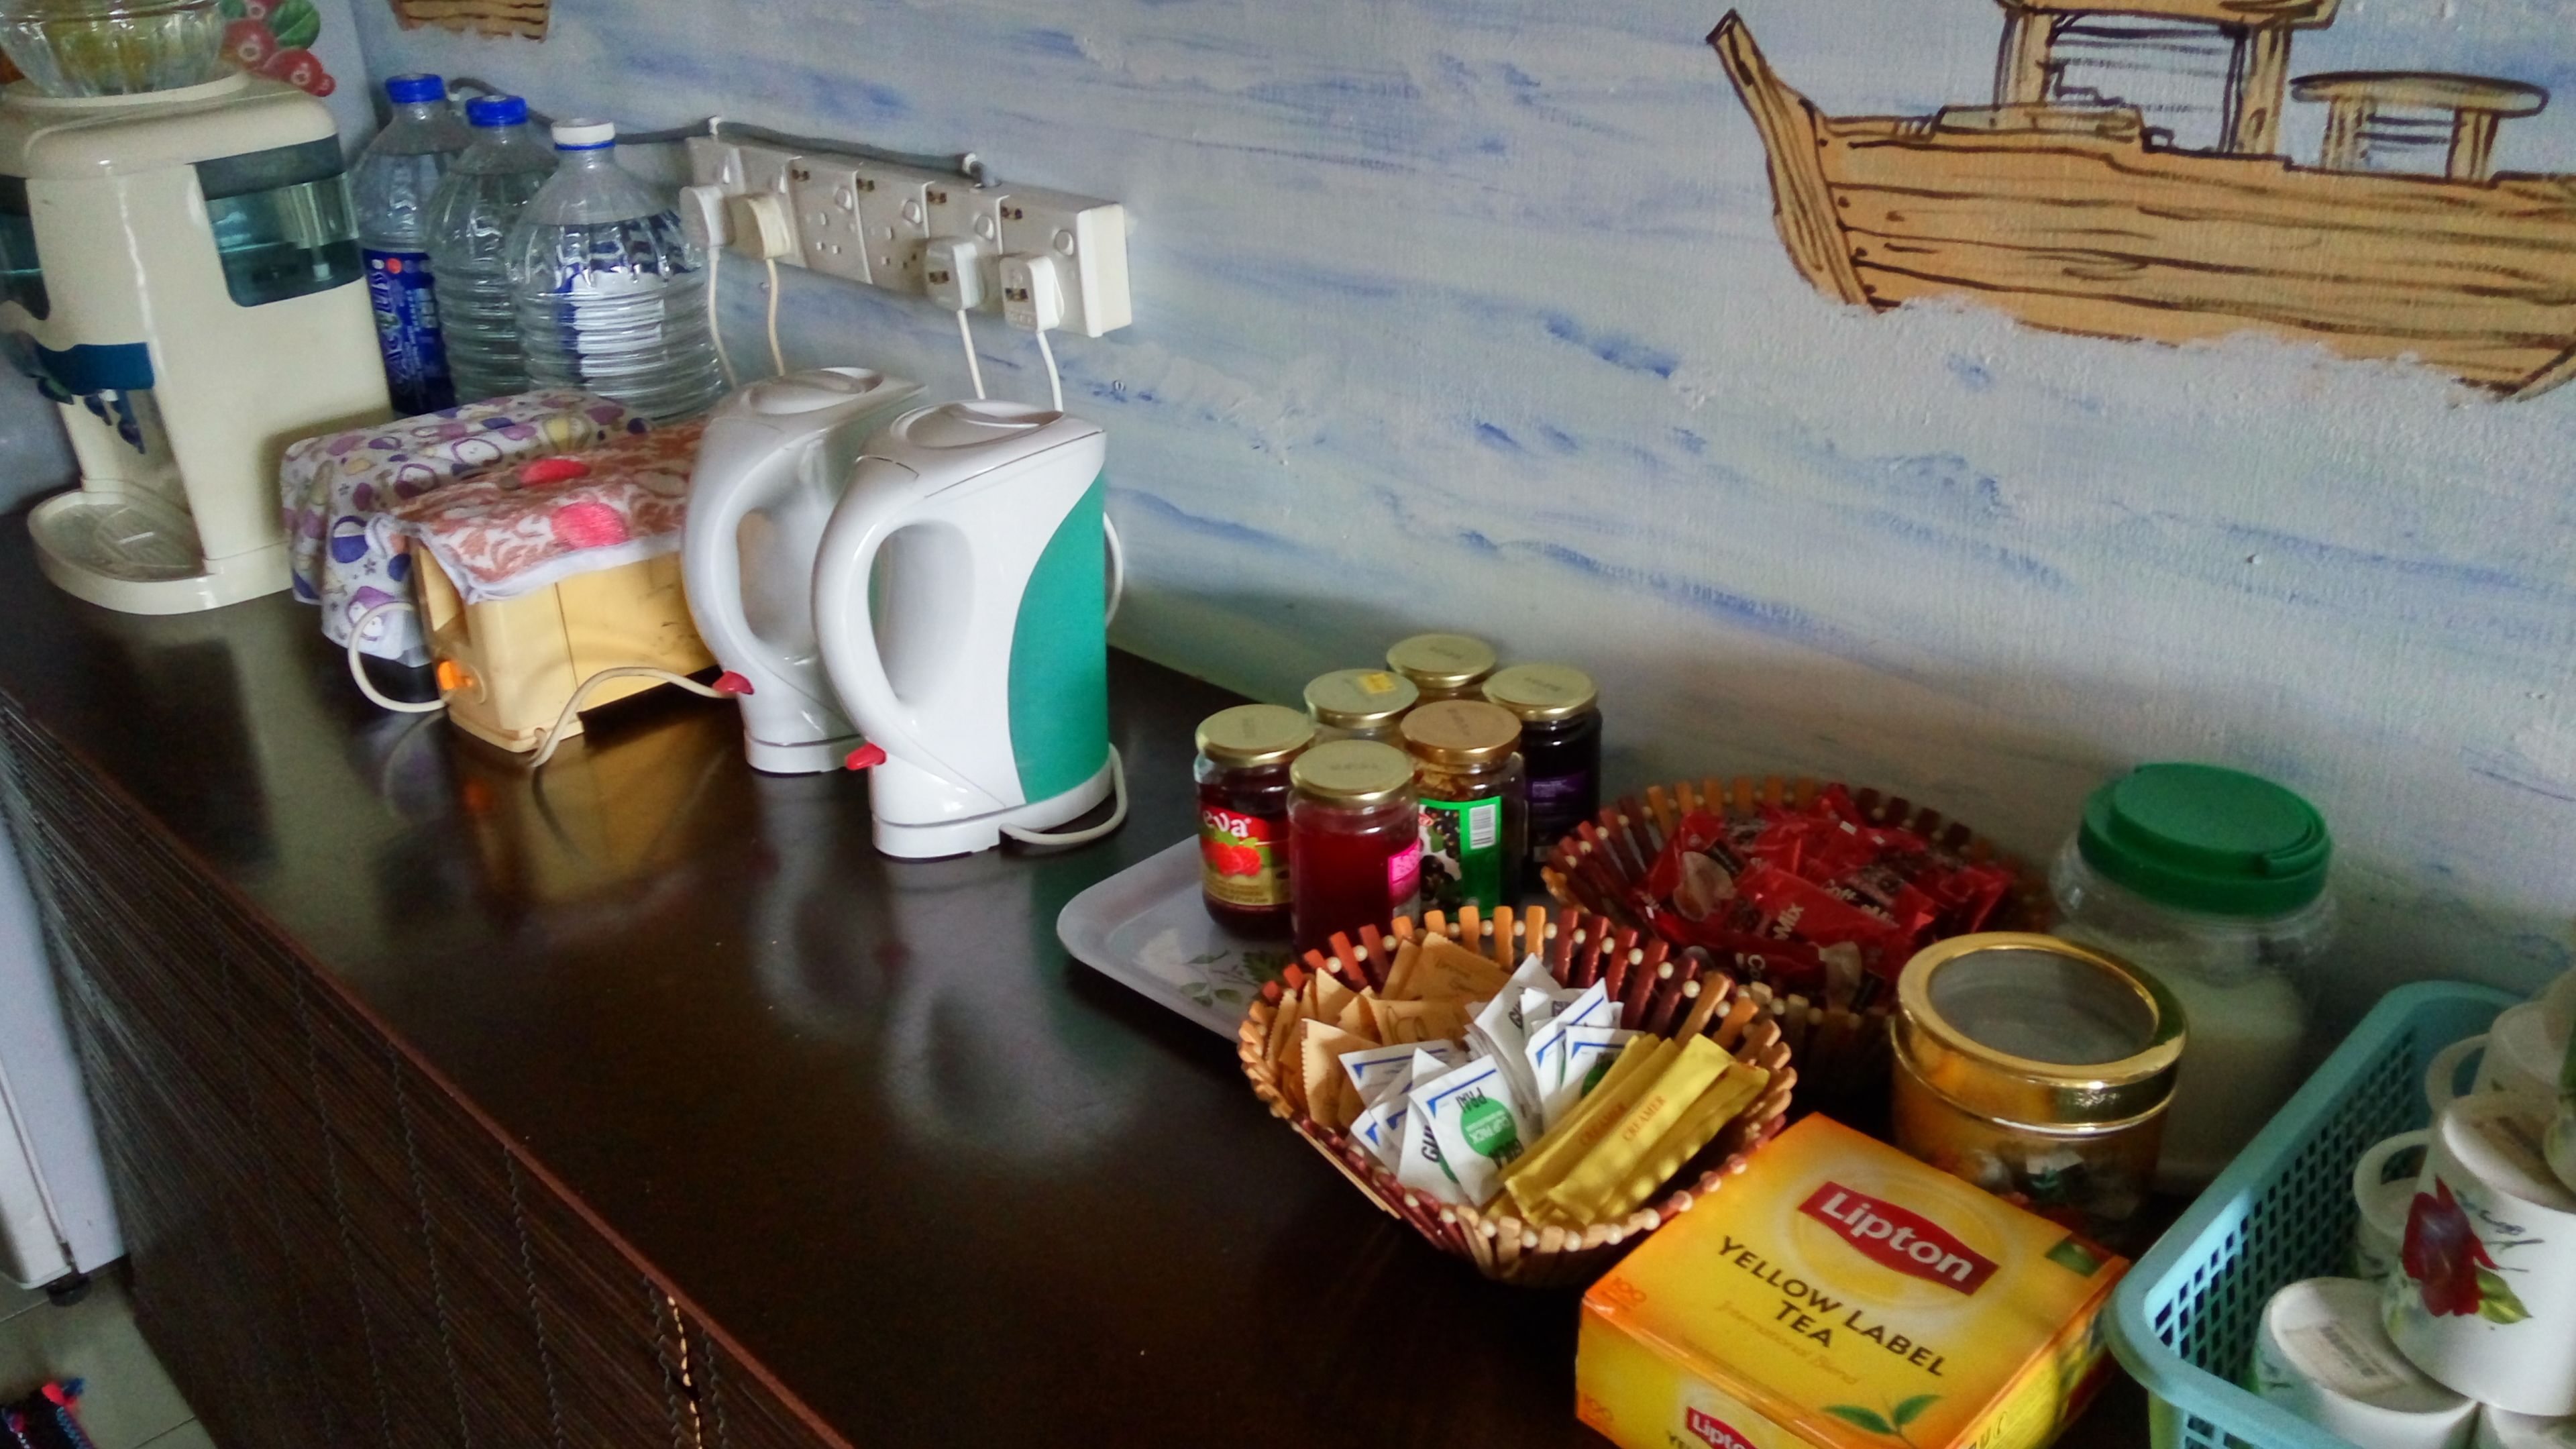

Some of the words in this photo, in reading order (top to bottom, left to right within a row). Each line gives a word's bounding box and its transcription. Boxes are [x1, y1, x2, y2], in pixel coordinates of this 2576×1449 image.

[1621, 1095, 1666, 1142] CREAMER
[1819, 1191, 1974, 1282] Lipton
[1718, 1235, 1843, 1313] YELLOW
[1843, 1309, 1945, 1377] LABEL
[1775, 1299, 1834, 1348] TEA
